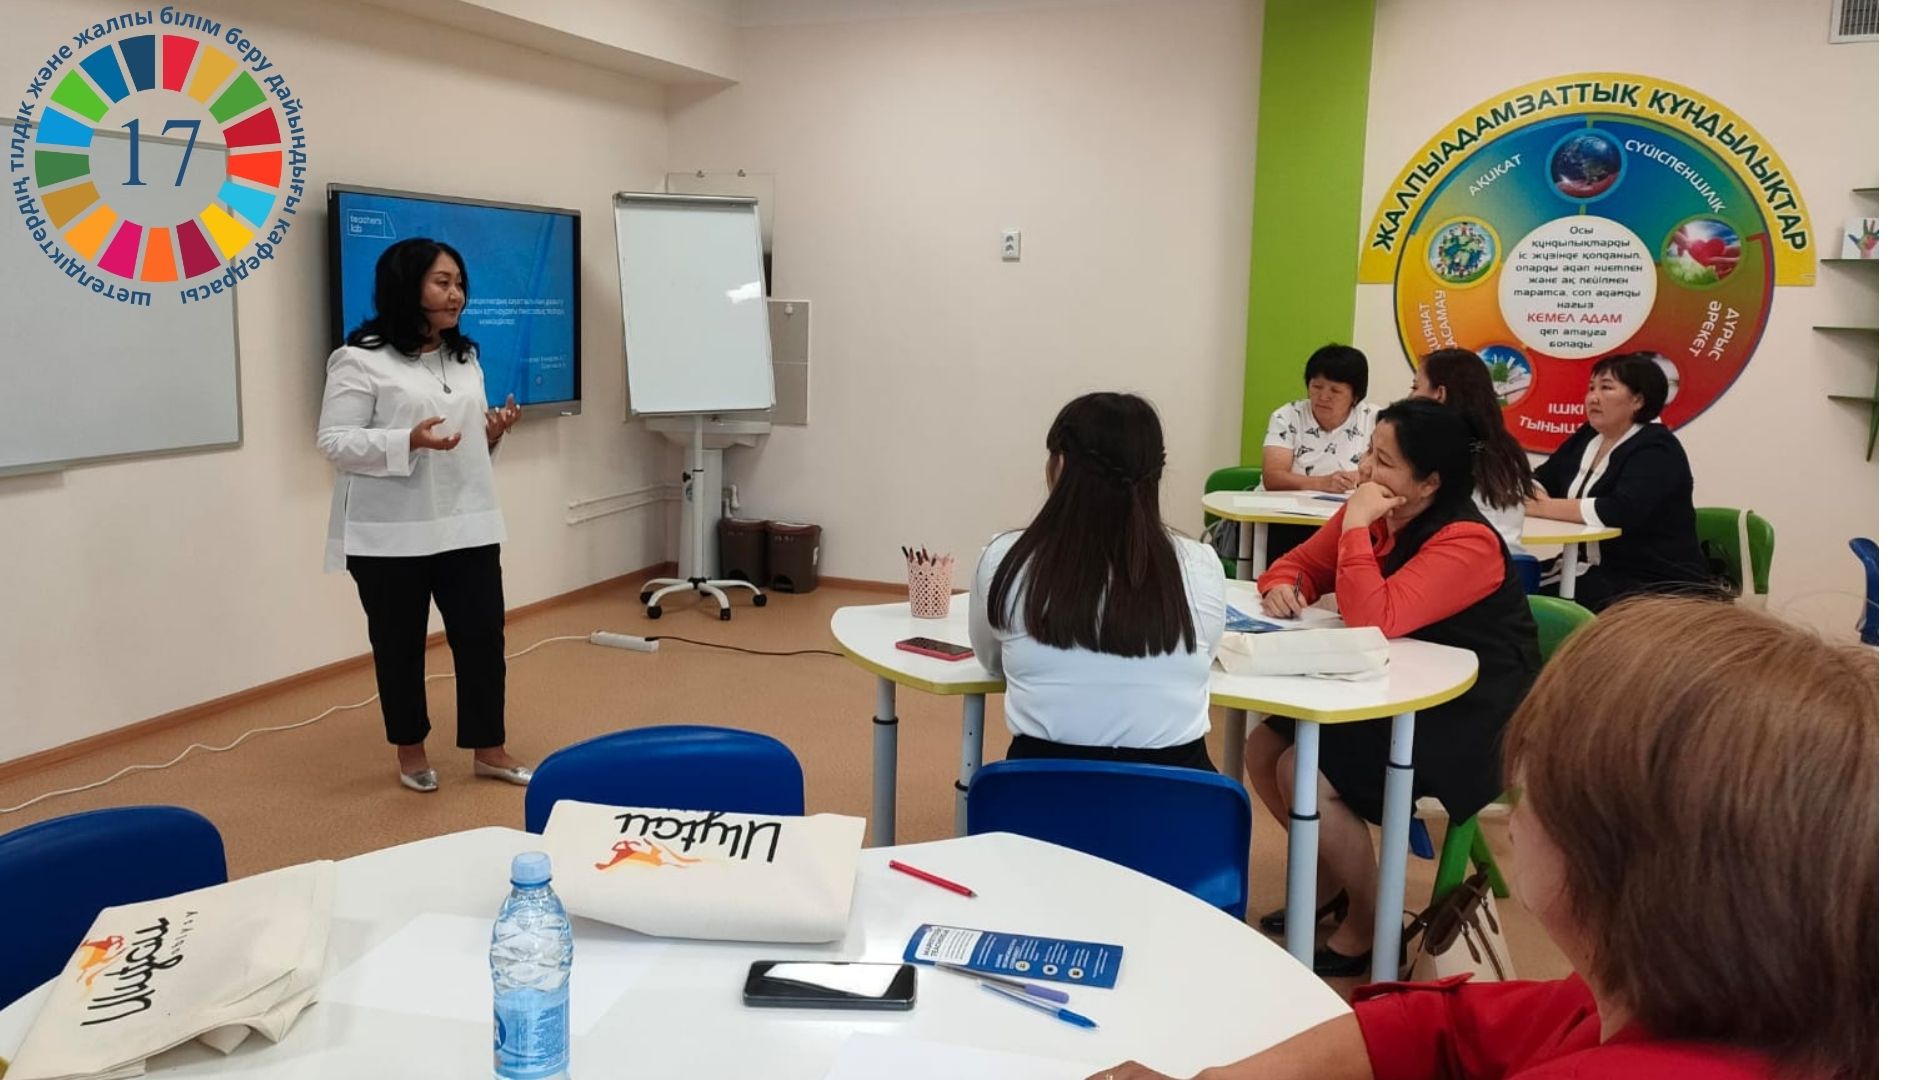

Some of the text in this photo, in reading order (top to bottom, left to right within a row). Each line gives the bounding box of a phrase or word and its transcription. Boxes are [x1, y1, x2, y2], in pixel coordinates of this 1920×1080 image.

[1373, 83, 1641, 251] ЖАЛПЫАДАМЗАТТЫҚ
[1625, 138, 1727, 213] СҮЙІСПЕНШІЛІК
[1569, 226, 1594, 235] Осы
[1519, 251, 1528, 260] іс
[1572, 289, 1592, 297] сол
[1434, 289, 1458, 349] АСАМАУ
[1527, 312, 1622, 324] КЕМЕЛ АДАМ
[1540, 328, 1559, 337] деп
[1689, 300, 1722, 357] ӘРЕКЕТ
[1548, 402, 1584, 415] ІШКІ
[615, 812, 782, 864] Ulytau
